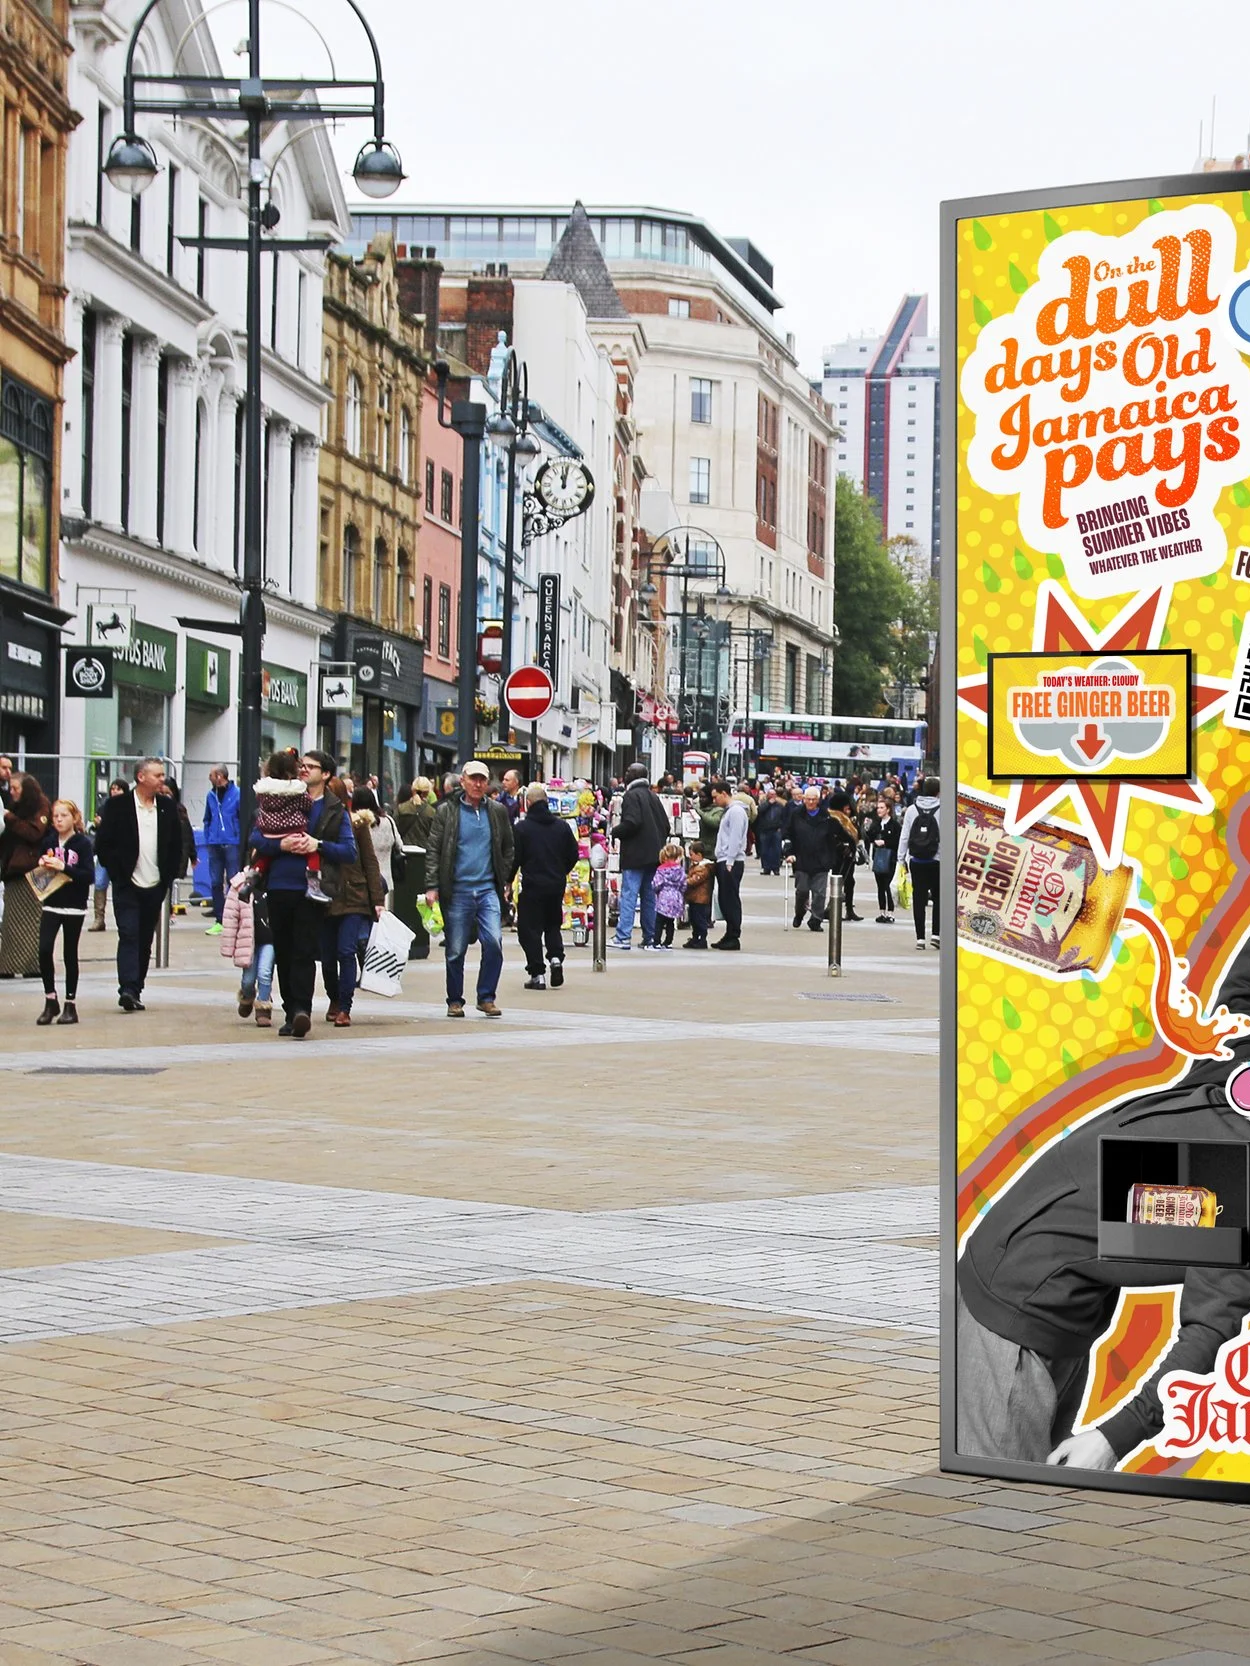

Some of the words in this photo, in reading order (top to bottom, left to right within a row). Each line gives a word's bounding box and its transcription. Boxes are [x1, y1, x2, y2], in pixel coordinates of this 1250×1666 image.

[1036, 229, 1221, 346] dull
[1093, 260, 1124, 281] On
[1127, 256, 1157, 276] the
[984, 337, 1118, 403] days
[1122, 327, 1217, 387] Old
[991, 380, 1238, 471] Jamaica
[1042, 415, 1241, 529] pays
[1076, 495, 1150, 535] BRINGING
[1082, 521, 1146, 557] SUMMER
[1145, 508, 1191, 538] VIBES
[1089, 552, 1140, 576] WHATEVER
[1140, 548, 1158, 564] THE
[1158, 538, 1203, 560] WEATHER
[545, 579, 554, 631] QUEENS
[142, 640, 167, 673] BANK
[281, 680, 299, 708] BANK
[1012, 692, 1052, 718] FREE
[1057, 691, 1122, 718] GINGER
[1127, 690, 1170, 717] BEER
[1043, 676, 1072, 688] TODAY'S
[1074, 675, 1111, 687] WEATHER:
[1112, 675, 1139, 687] CLOUDY
[957, 840, 991, 892] BEER
[976, 838, 1021, 911] GINGER
[1008, 843, 1057, 930] Jamaica
[1034, 872, 1066, 917] Old
[1155, 1199, 1165, 1218] BEER
[1165, 1196, 1176, 1222] GINGER
